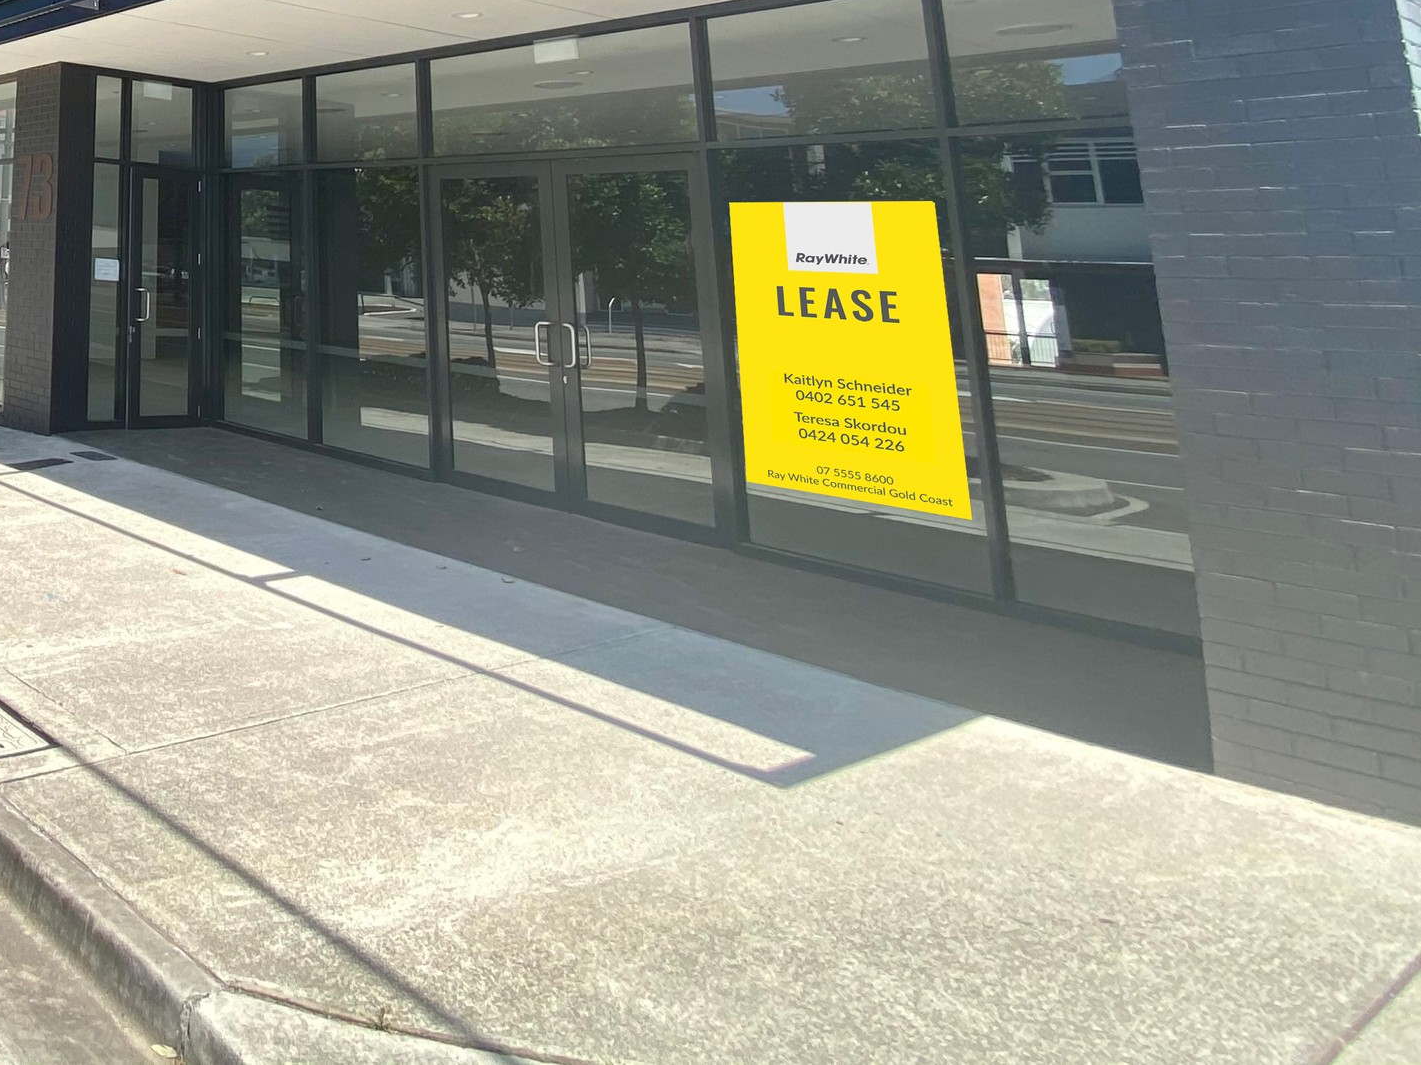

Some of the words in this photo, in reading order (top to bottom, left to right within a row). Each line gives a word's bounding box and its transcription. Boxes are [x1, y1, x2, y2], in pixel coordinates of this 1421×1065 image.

[16, 152, 54, 221] 73
[776, 285, 900, 324] LEASE
[783, 373, 833, 389] Kaitlyn
[837, 378, 912, 396] Schneider
[795, 389, 833, 405] 0402
[837, 394, 866, 408] 651
[871, 397, 901, 412] 545
[793, 411, 840, 427] Teresa
[844, 417, 907, 436] Skordou
[798, 428, 837, 443] 0424
[840, 433, 870, 448] 054
[875, 437, 905, 452] 226
[816, 465, 830, 476] 07
[833, 468, 862, 480] 5555
[864, 472, 894, 485] 8600
[767, 469, 786, 481] Ray
[787, 472, 820, 485] White
[822, 478, 886, 496] Commercial
[889, 488, 917, 501] Gold
[919, 493, 954, 507] Coast
